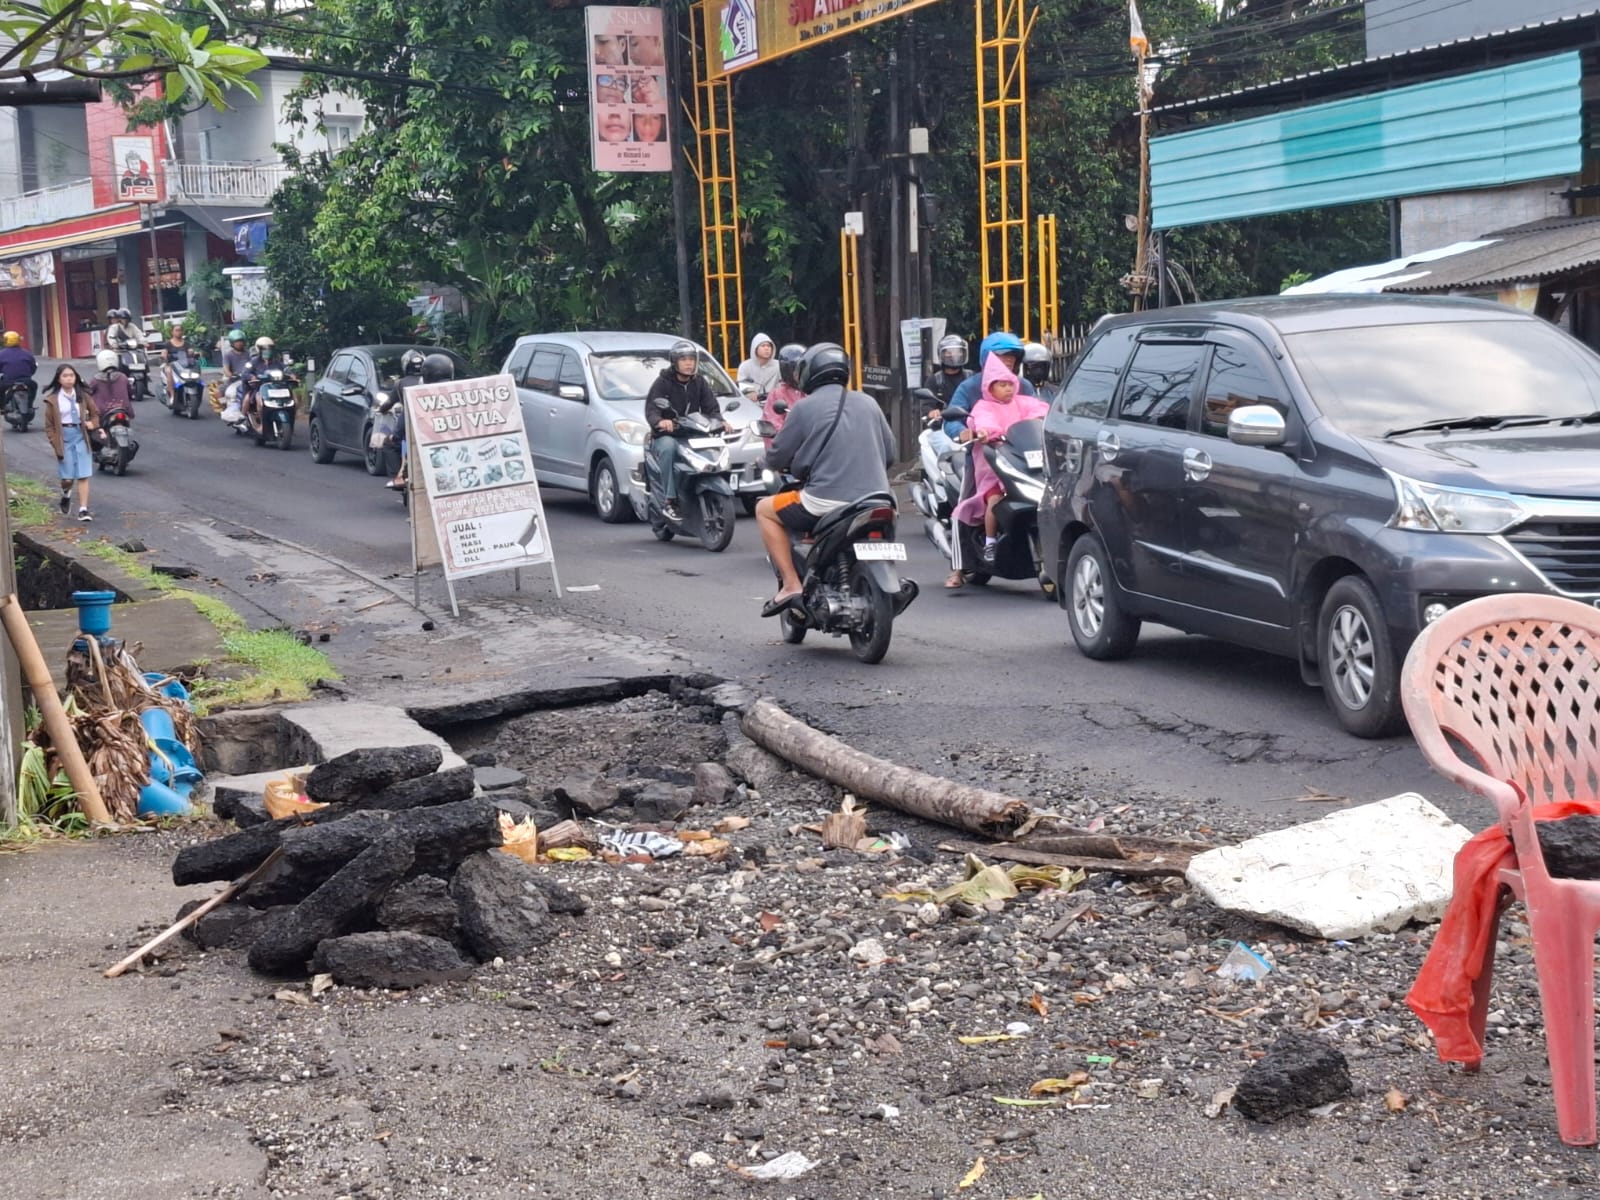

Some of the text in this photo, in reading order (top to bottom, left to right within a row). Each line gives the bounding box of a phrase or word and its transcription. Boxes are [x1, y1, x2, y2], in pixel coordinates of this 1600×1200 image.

[416, 386, 511, 412] WARUNG
[432, 410, 507, 433] BU VIA
[452, 522, 477, 533] JUAL
[459, 533, 477, 541] KUE
[461, 540, 482, 548] NASI
[462, 547, 486, 556] LAUK
[493, 541, 516, 550] PAUK
[464, 555, 480, 563] DLL
